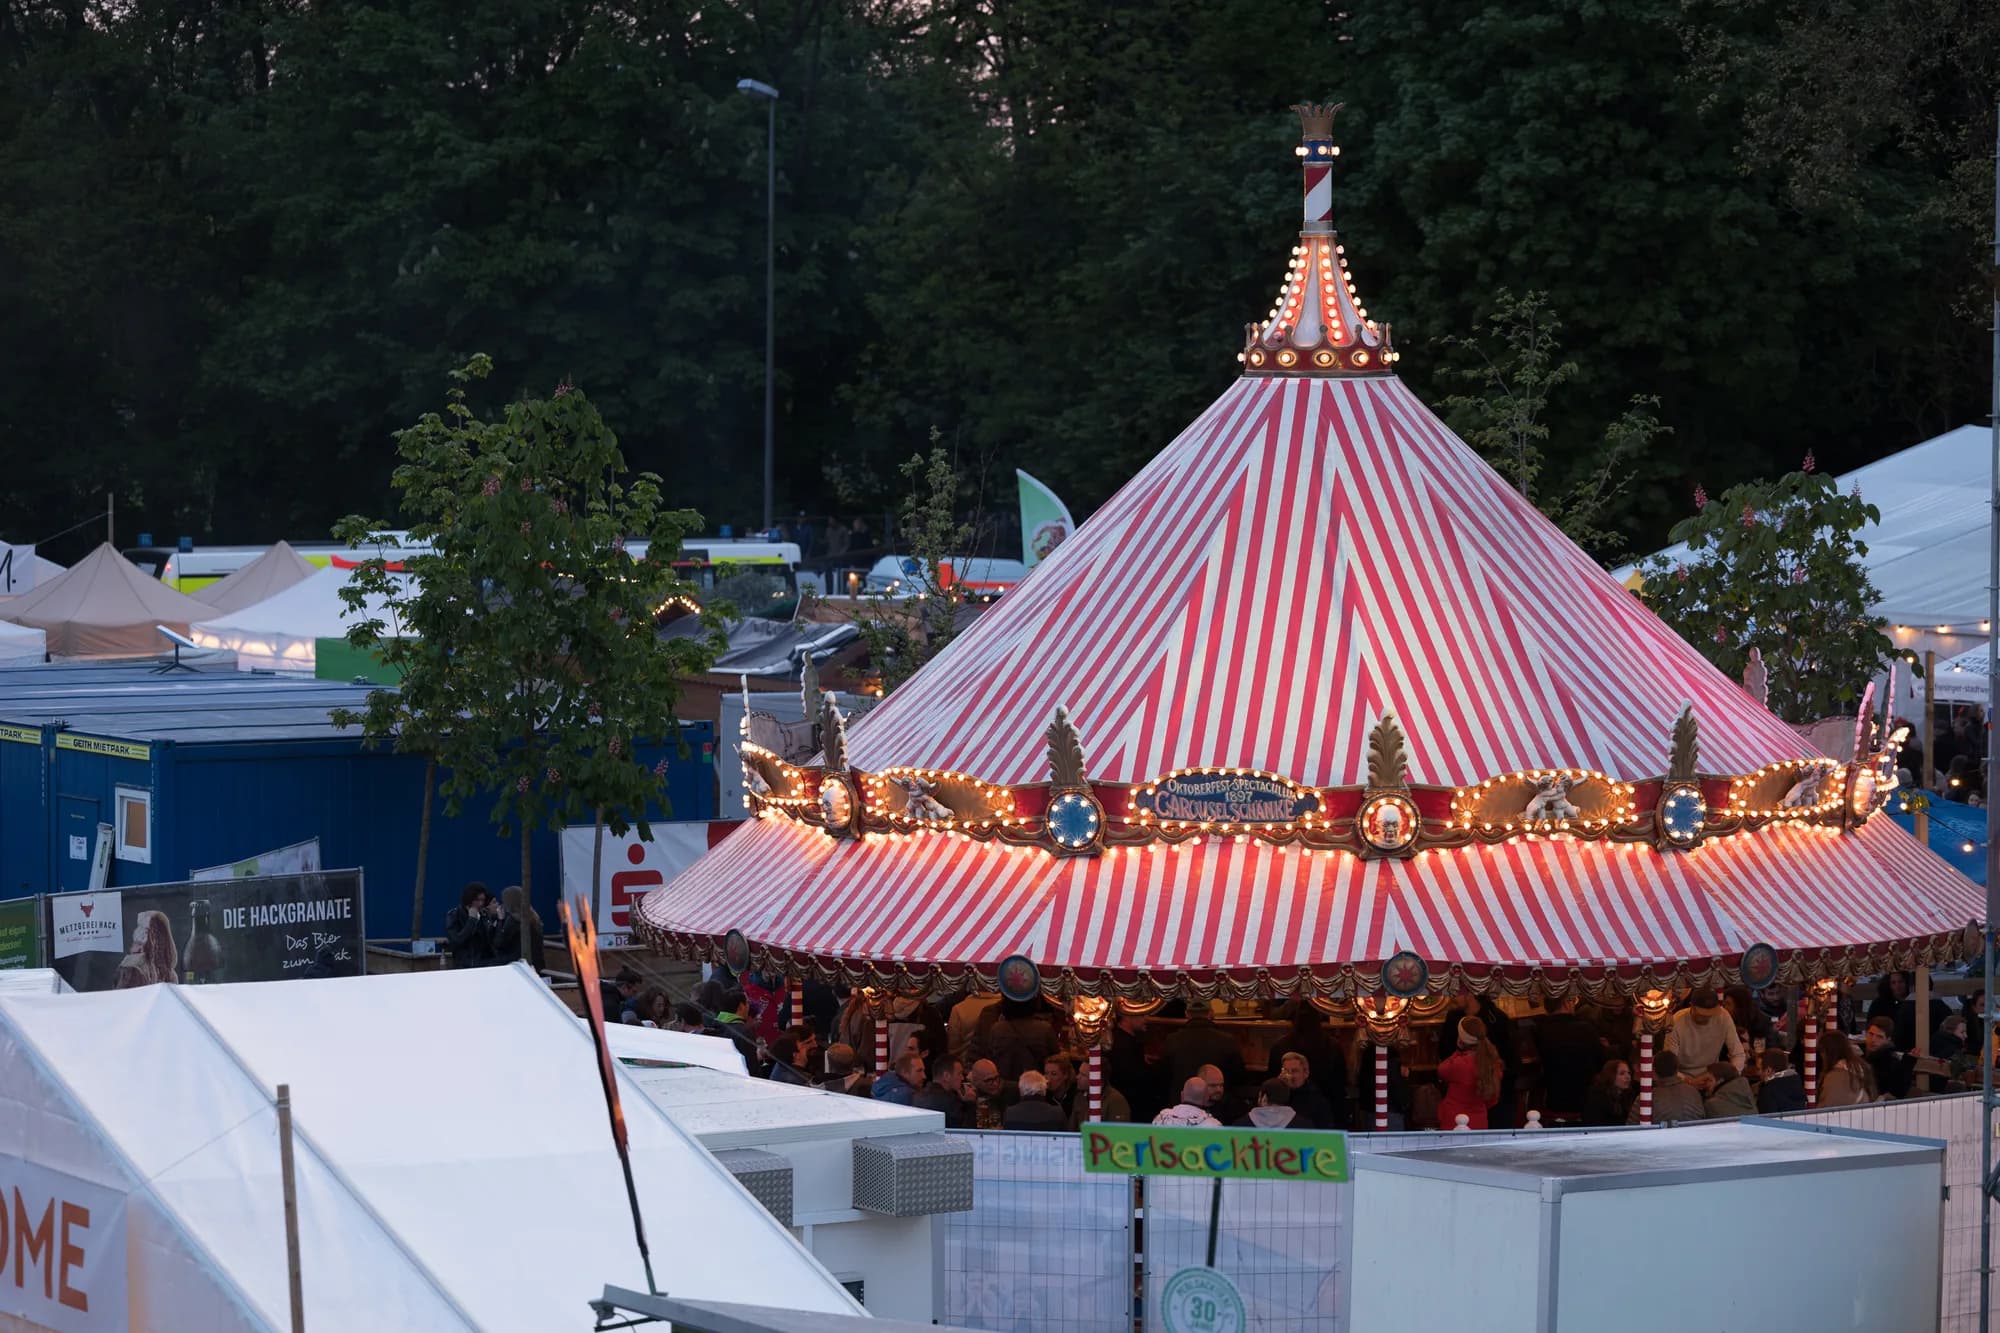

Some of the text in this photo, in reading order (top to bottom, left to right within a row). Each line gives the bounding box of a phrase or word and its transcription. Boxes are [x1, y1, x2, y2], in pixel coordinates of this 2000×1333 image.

[73, 738, 130, 755] GEITH MIETPARK
[1155, 790, 1231, 822] CAROUSEL
[1225, 790, 1253, 802] 1897
[223, 898, 352, 929] DIE HACKGRANATE
[59, 921, 117, 935] METZGEREI HACK
[285, 932, 341, 951] Das Bier
[282, 957, 314, 969] zum
[1089, 1131, 1341, 1177] Perlsacktiere
[0, 1184, 90, 1313] ME
[1190, 1296, 1217, 1322] 30
